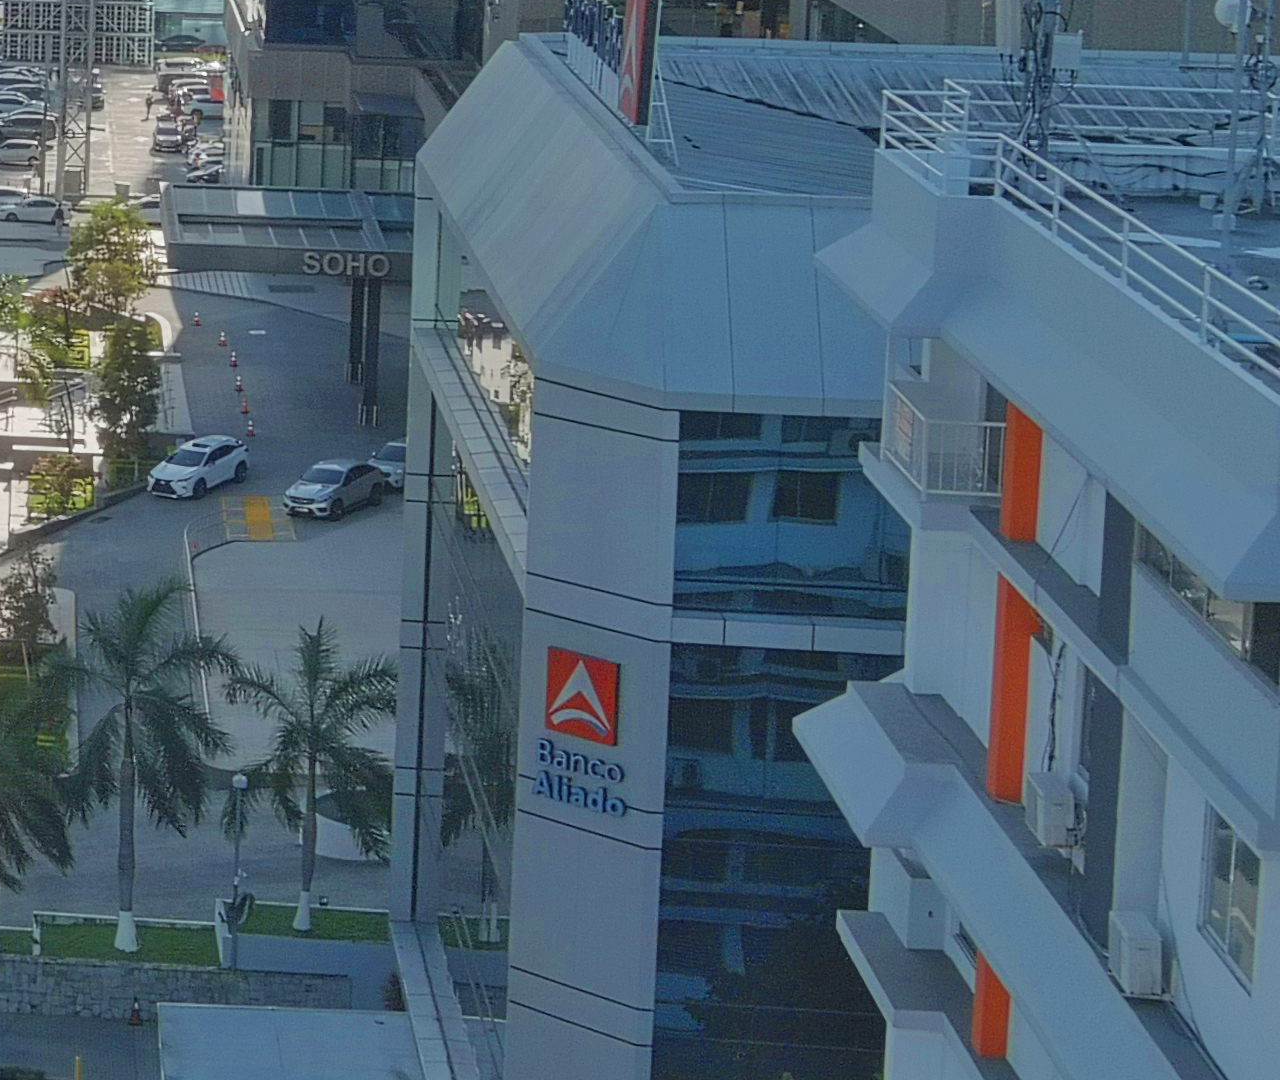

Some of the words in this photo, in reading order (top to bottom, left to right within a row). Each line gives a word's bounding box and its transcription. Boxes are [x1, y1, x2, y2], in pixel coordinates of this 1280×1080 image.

[302, 251, 391, 277] SOHO
[536, 738, 624, 783] Banco
[533, 770, 627, 817] Aliado
